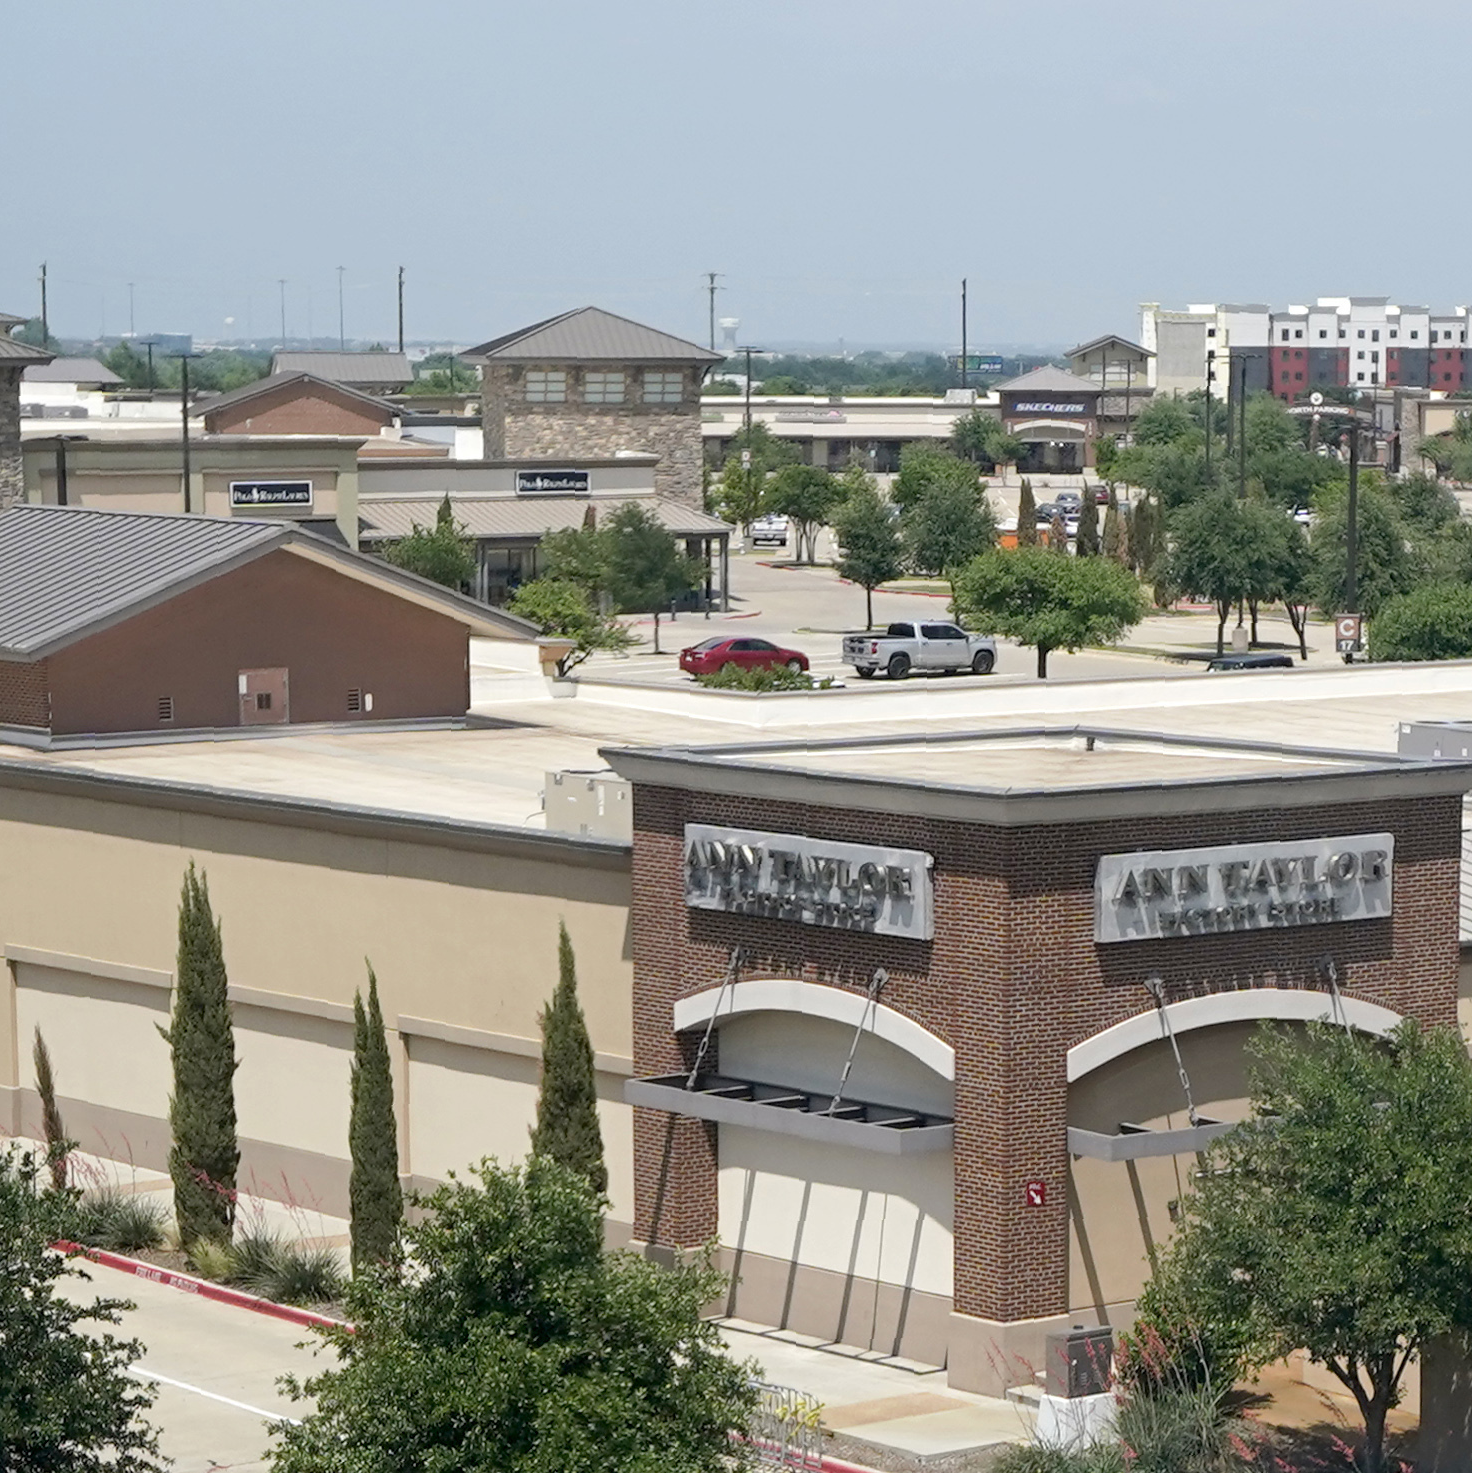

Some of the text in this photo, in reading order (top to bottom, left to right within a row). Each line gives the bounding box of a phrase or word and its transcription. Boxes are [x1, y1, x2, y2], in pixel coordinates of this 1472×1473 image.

[1015, 402, 1085, 413] SKECHERS
[1314, 405, 1350, 415] PARKING
[1339, 619, 1355, 637] C
[1340, 640, 1355, 651] 17
[685, 839, 915, 900] ANN TAYLOR
[1113, 849, 1390, 907] ANN TAYLOR
